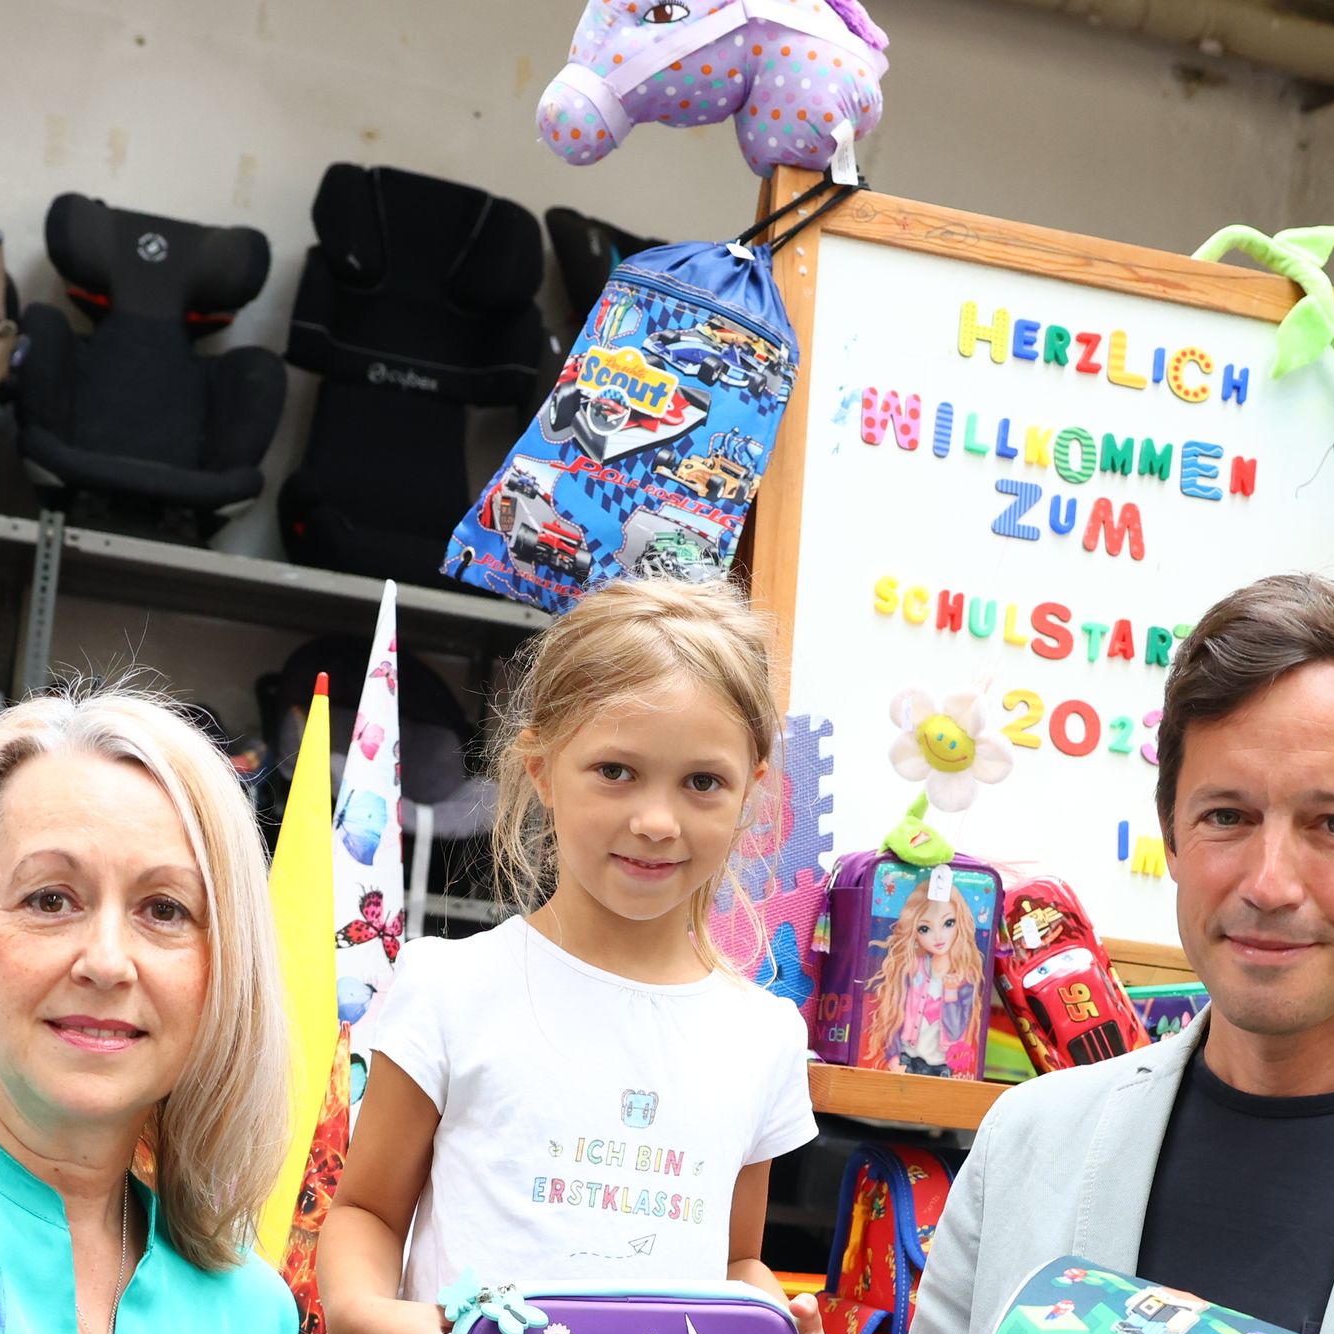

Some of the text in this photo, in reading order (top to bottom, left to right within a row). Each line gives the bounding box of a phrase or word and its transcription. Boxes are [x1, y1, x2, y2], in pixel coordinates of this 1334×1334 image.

[581, 355, 667, 408] Scout
[958, 300, 1250, 405] HERZLICH
[859, 385, 1258, 501] WILLKOMMEN
[990, 478, 1146, 561] ZUM
[873, 575, 1195, 668] SCHULSTAR
[1057, 982, 1100, 1023] 95
[575, 1137, 685, 1176] ICH BIN
[532, 1177, 705, 1224] ERSTKLASSIG
